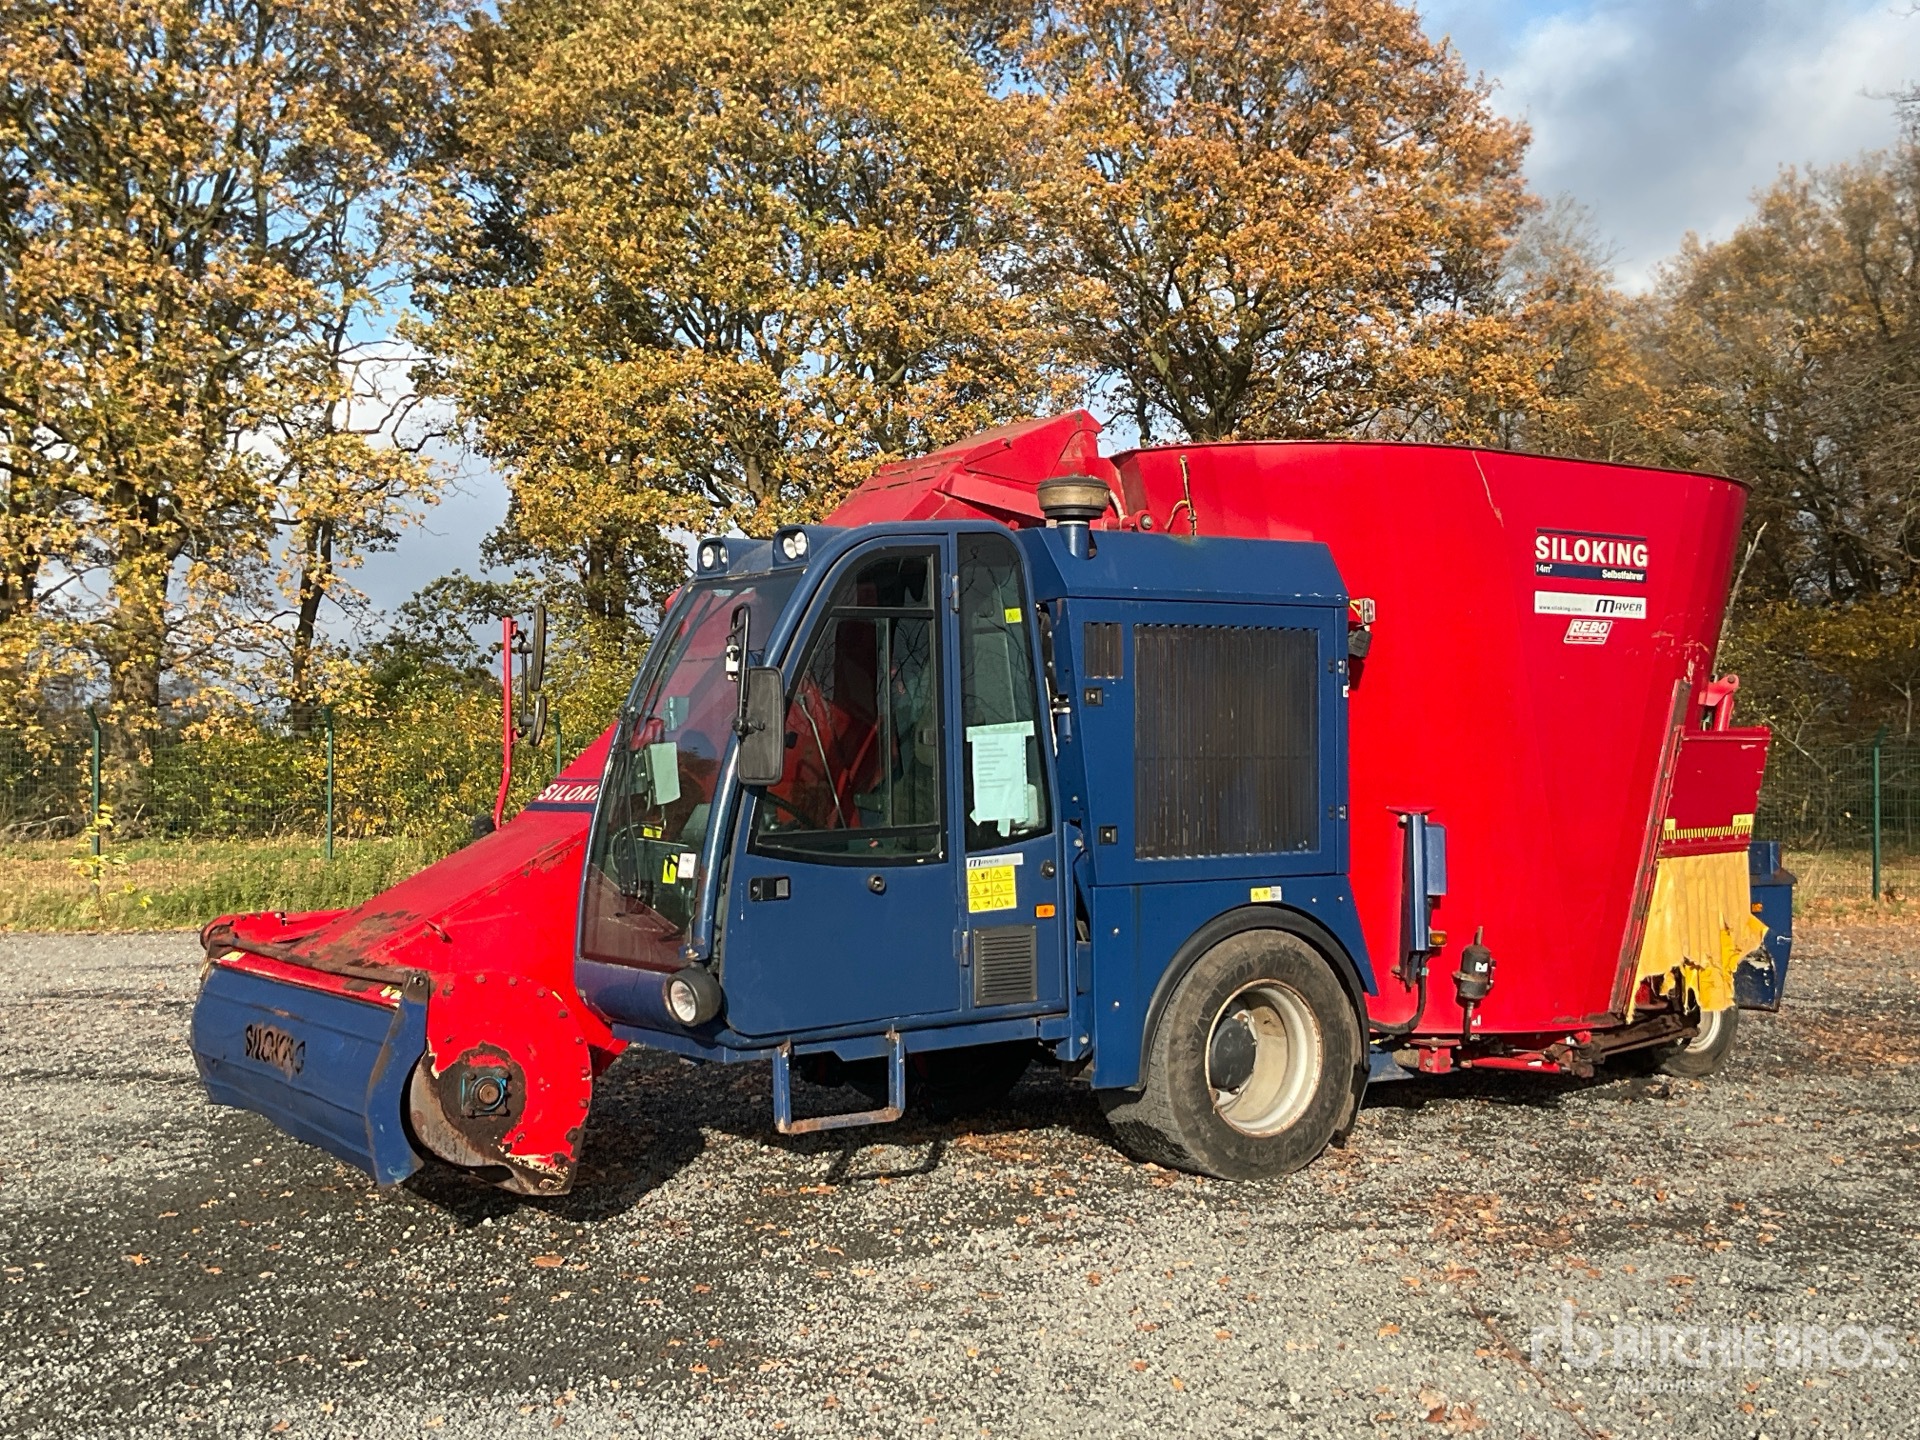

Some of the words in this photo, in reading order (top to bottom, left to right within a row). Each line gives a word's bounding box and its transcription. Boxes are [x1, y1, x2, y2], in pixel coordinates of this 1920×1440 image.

[1535, 535, 1648, 567] SILOKING
[1602, 569, 1644, 581] Selbstfahrer
[1595, 599, 1642, 613] MAYER
[1571, 621, 1608, 633] REBO
